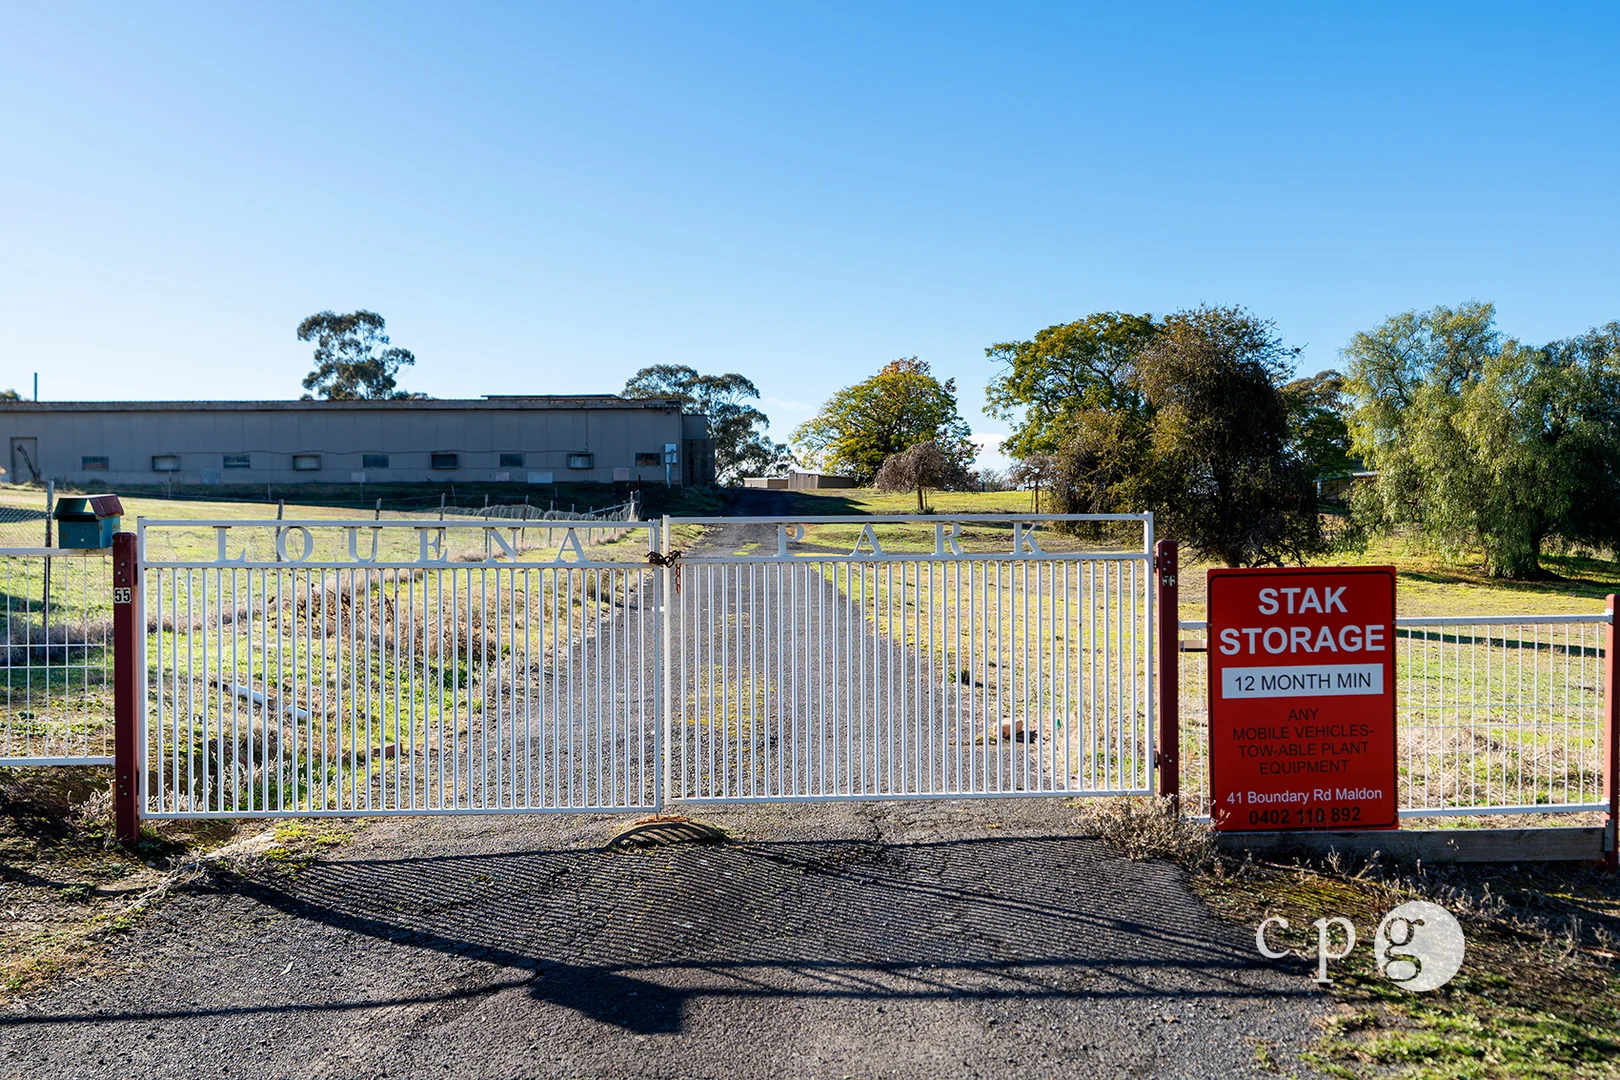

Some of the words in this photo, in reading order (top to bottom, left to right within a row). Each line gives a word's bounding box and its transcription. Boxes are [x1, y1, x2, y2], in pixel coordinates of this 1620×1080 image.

[213, 525, 590, 563] LOUENA
[773, 521, 1046, 556] PARK
[114, 588, 131, 603] 55
[1258, 586, 1348, 615] STAK
[1219, 624, 1386, 655] STORAGE
[1234, 676, 1255, 692] 12
[1261, 673, 1331, 691] MONTH
[1337, 672, 1371, 689] MIN
[1288, 708, 1319, 721] ANY
[1233, 726, 1290, 740] MOBILE
[1238, 743, 1317, 758] TOW-ABLE
[1321, 741, 1370, 755] PLANT
[1259, 760, 1349, 775] EQUIPMENT
[1227, 792, 1243, 804] 41
[1247, 790, 1310, 805] Boundary
[1313, 788, 1332, 801] Rd
[1335, 787, 1383, 800] Maldon
[1249, 809, 1290, 825] 0402
[1296, 808, 1325, 823] 110
[1331, 806, 1361, 822] 892
